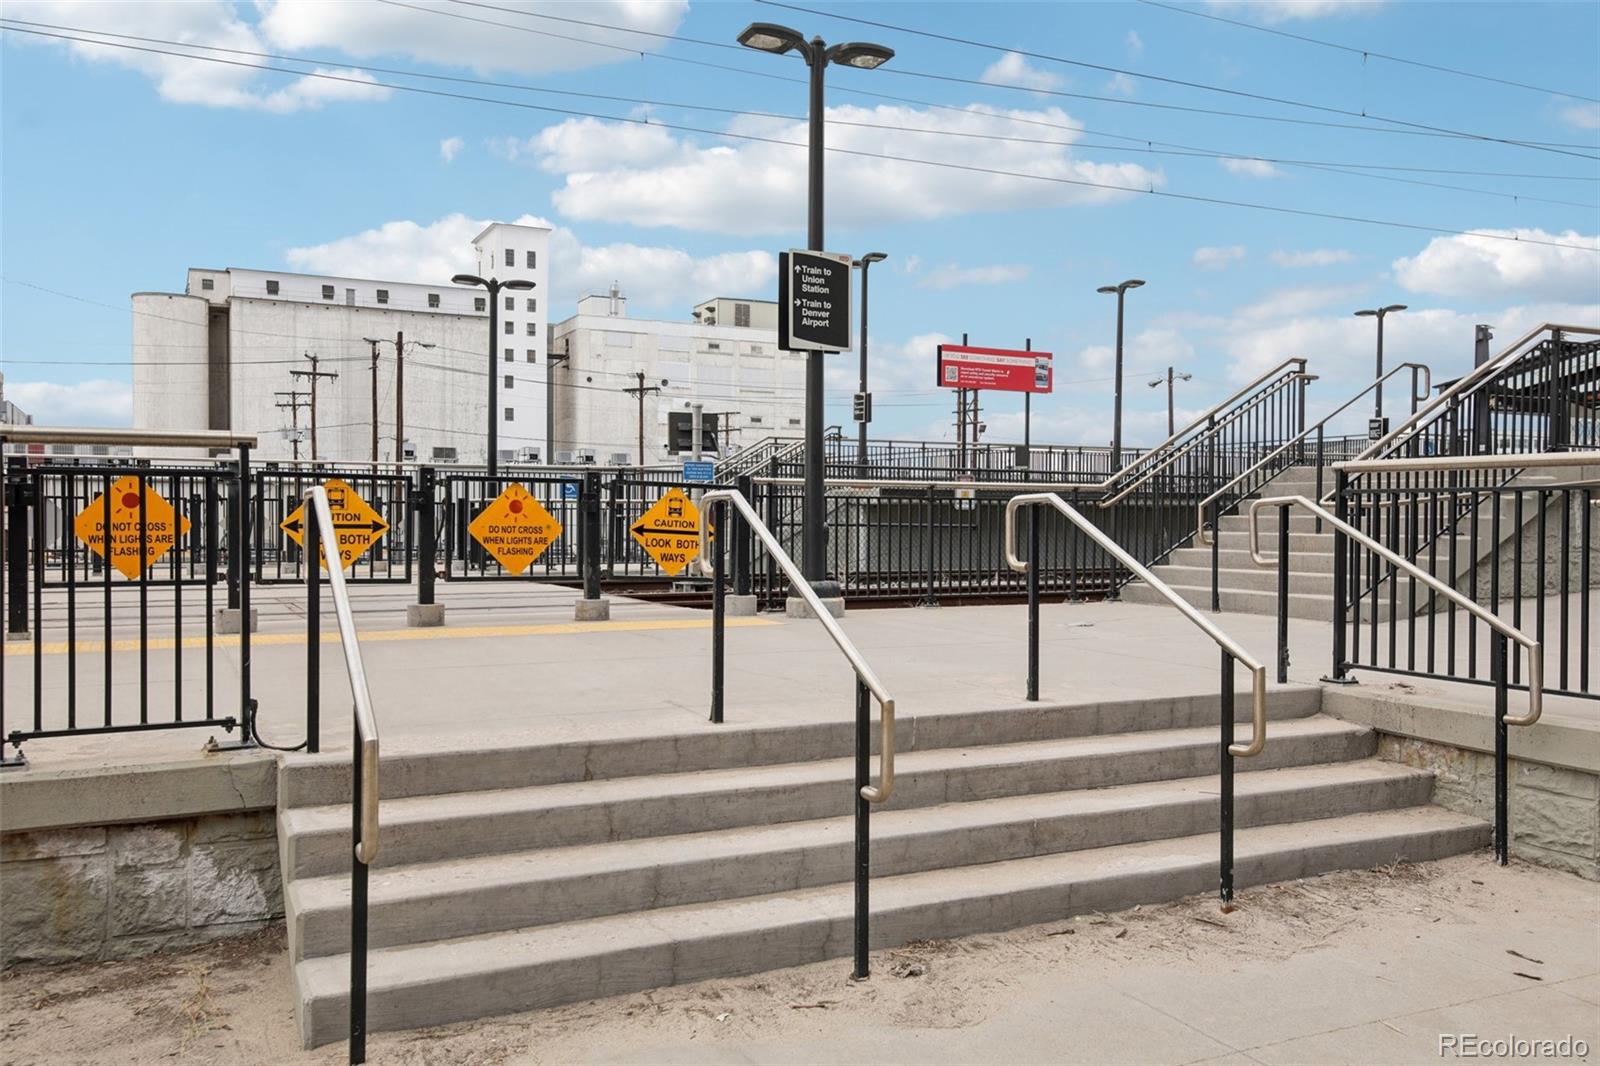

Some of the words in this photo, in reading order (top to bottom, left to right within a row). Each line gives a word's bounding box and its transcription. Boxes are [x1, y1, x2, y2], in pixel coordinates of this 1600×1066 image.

[801, 265, 822, 275] Train
[823, 267, 832, 276] to
[801, 274, 825, 284] Union
[801, 284, 830, 294] Station
[801, 298, 822, 308] Train
[823, 301, 832, 309] to
[801, 308, 830, 318] Denver
[801, 317, 830, 328] Airport
[112, 522, 132, 531] NOT
[134, 522, 167, 531] COSS
[654, 518, 695, 528] CAUTION
[488, 525, 500, 534] DO
[501, 525, 516, 534] NOT
[518, 526, 544, 535] CROSS
[88, 534, 117, 544] WHN
[119, 534, 153, 544] LIGHS
[154, 534, 174, 543] ARE
[340, 534, 370, 545] BOTH
[482, 536, 505, 545] WHEN
[506, 536, 532, 545] LIGHTS
[533, 537, 549, 545] ARE
[645, 538, 672, 548] LOOK
[497, 546, 534, 556] FLASHING
[660, 552, 686, 563] WAYS
